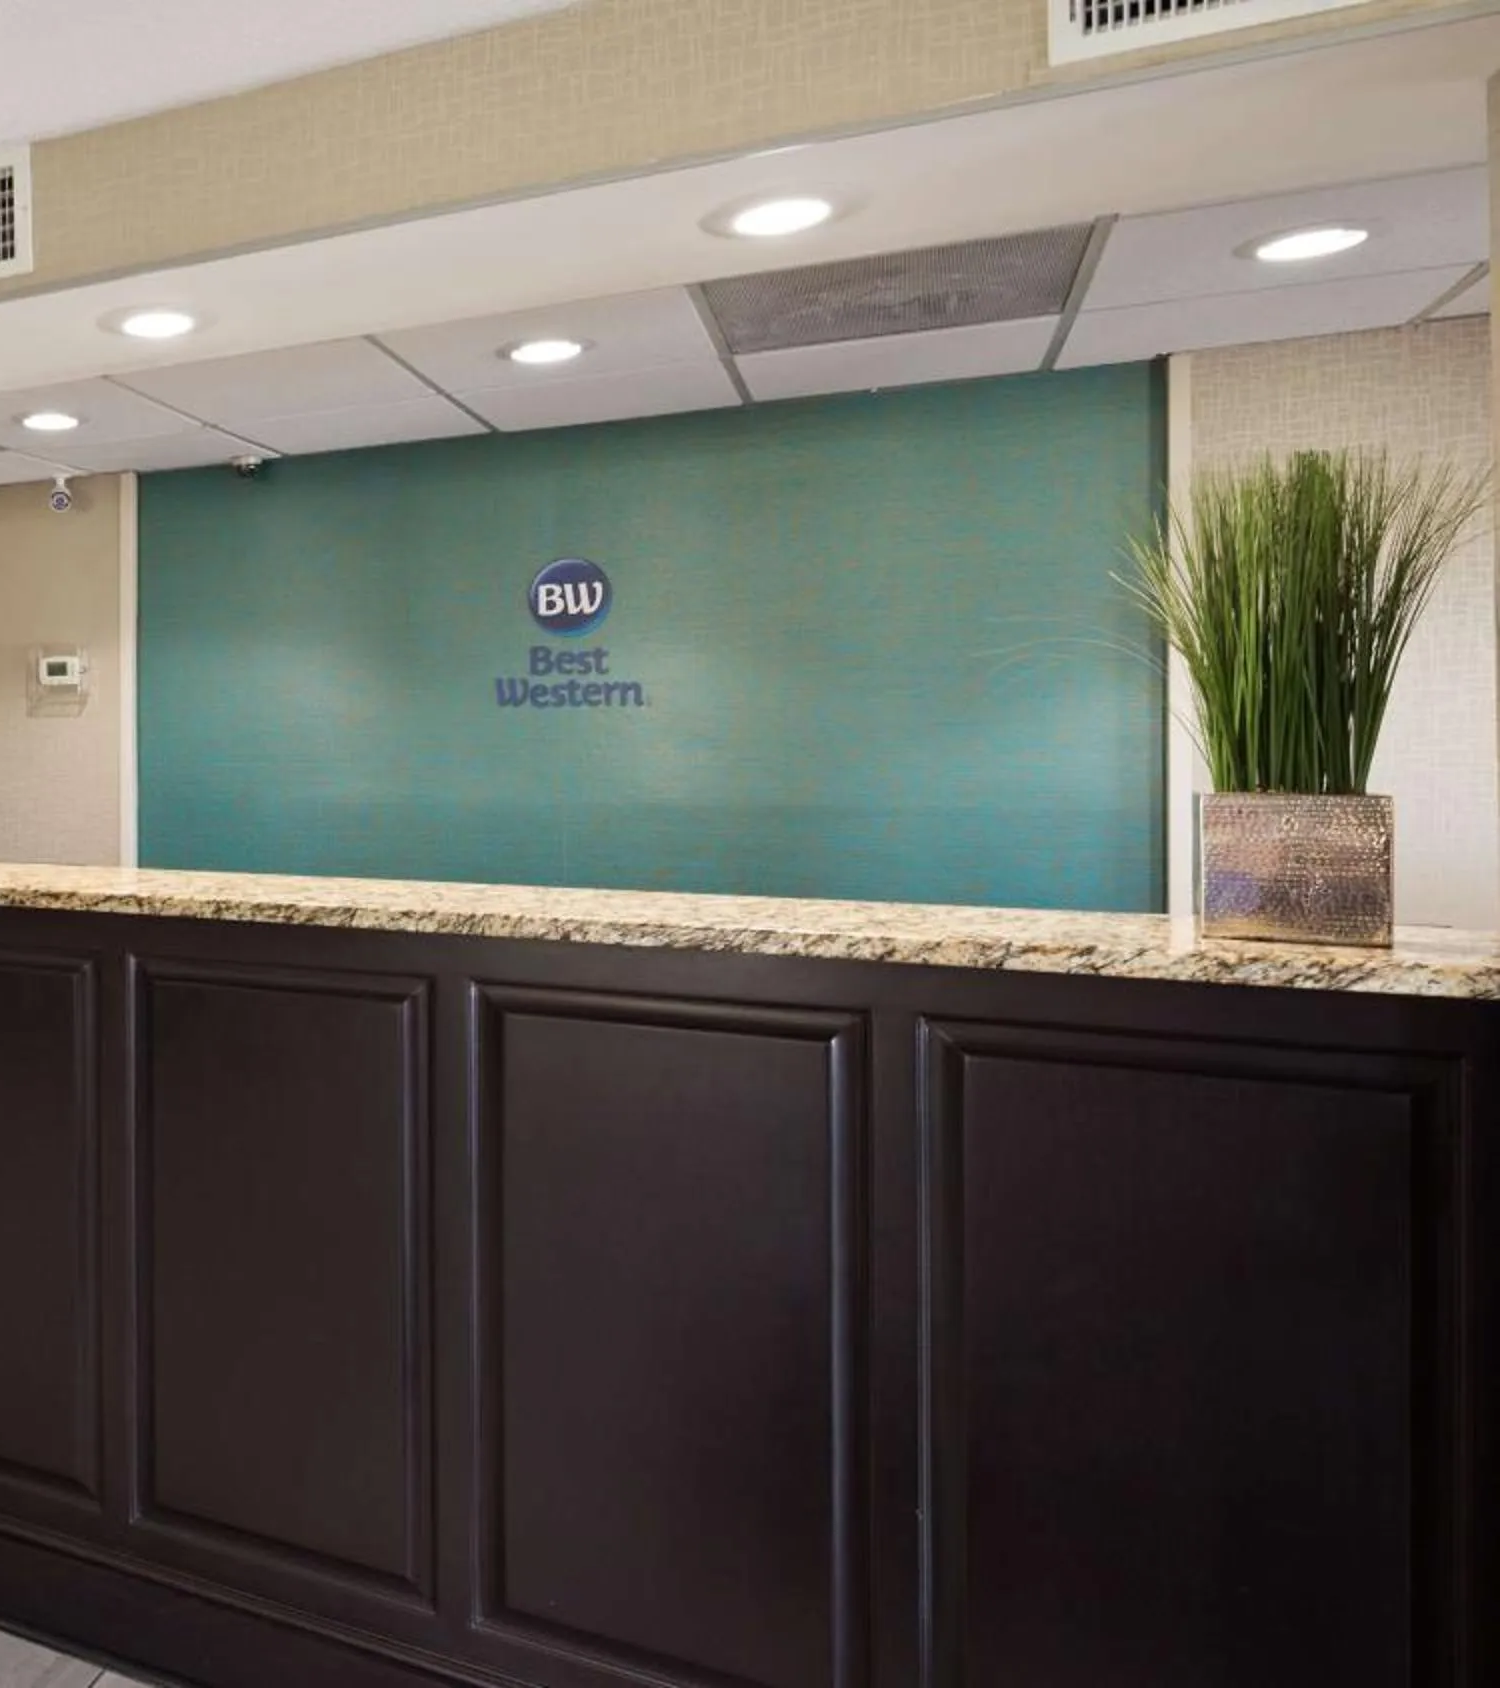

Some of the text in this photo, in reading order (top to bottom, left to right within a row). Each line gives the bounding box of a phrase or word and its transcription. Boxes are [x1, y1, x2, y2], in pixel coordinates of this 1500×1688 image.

[537, 581, 603, 617] BW
[529, 646, 610, 677] Best
[495, 678, 645, 709] Western
